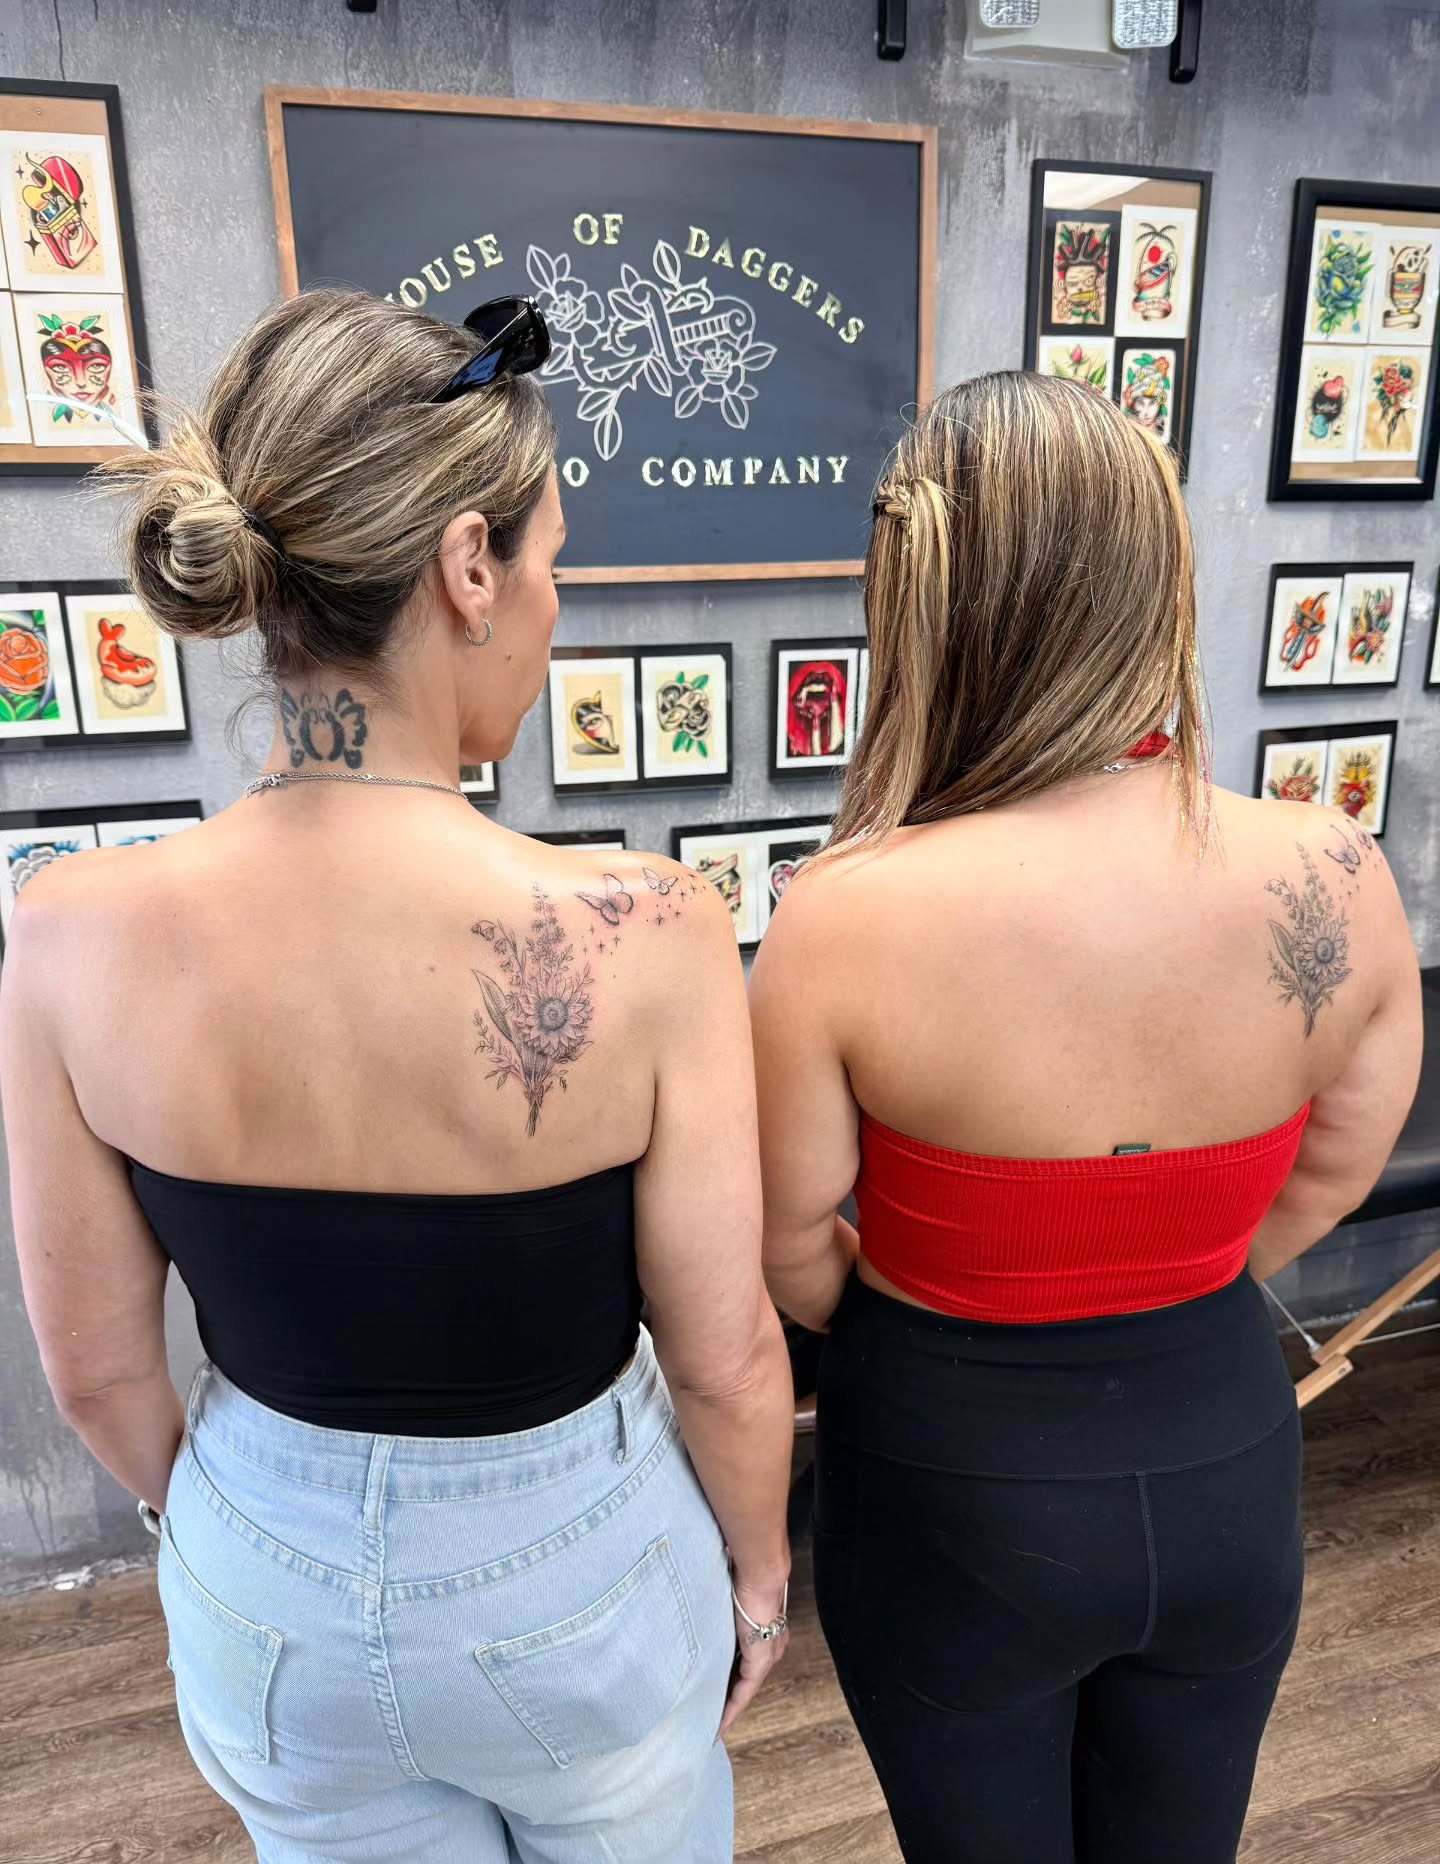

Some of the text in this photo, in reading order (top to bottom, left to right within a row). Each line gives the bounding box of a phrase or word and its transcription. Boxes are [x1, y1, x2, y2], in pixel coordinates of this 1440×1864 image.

[384, 213, 865, 344] OUSE OF DAGGERS
[641, 455, 849, 487] COMPANY
